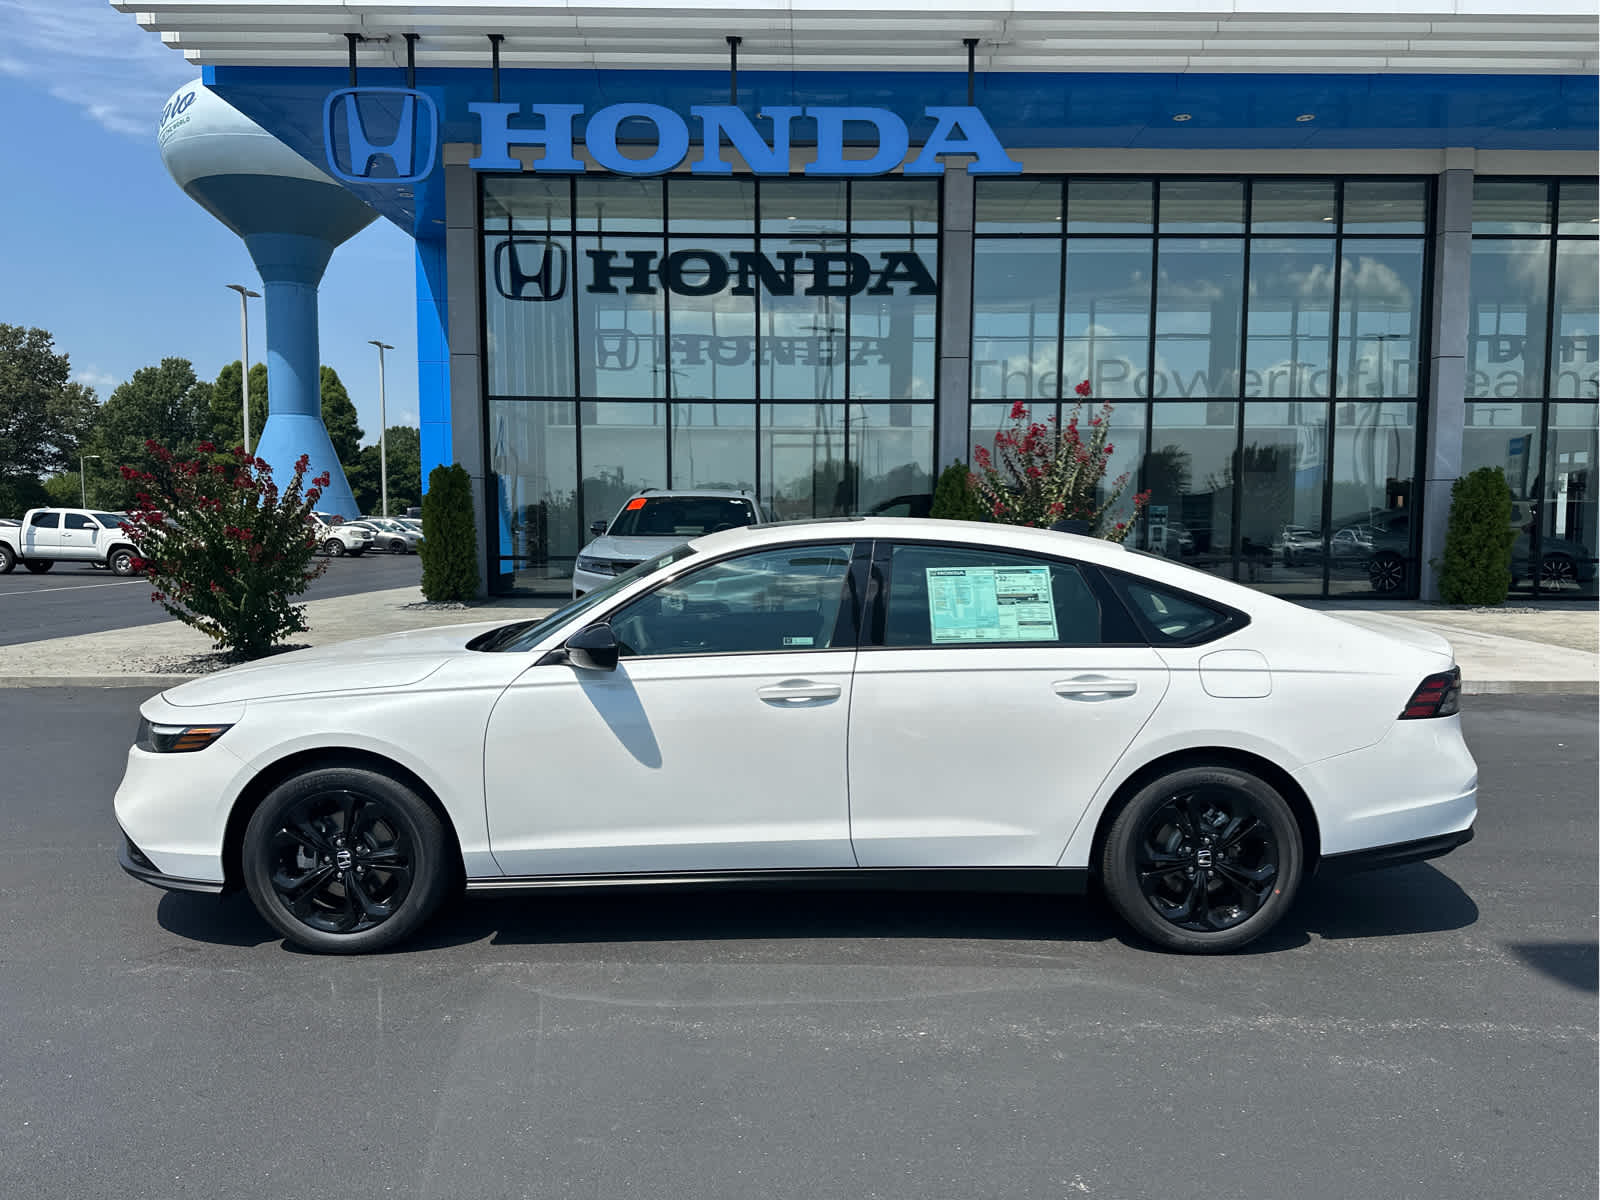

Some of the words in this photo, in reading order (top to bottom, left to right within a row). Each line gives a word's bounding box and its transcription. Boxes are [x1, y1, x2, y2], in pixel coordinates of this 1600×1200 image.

[468, 102, 1023, 177] HONDA
[585, 248, 938, 297] HONDA
[972, 359, 1069, 398] The
[1096, 359, 1289, 398] Power
[1309, 359, 1369, 398] of
